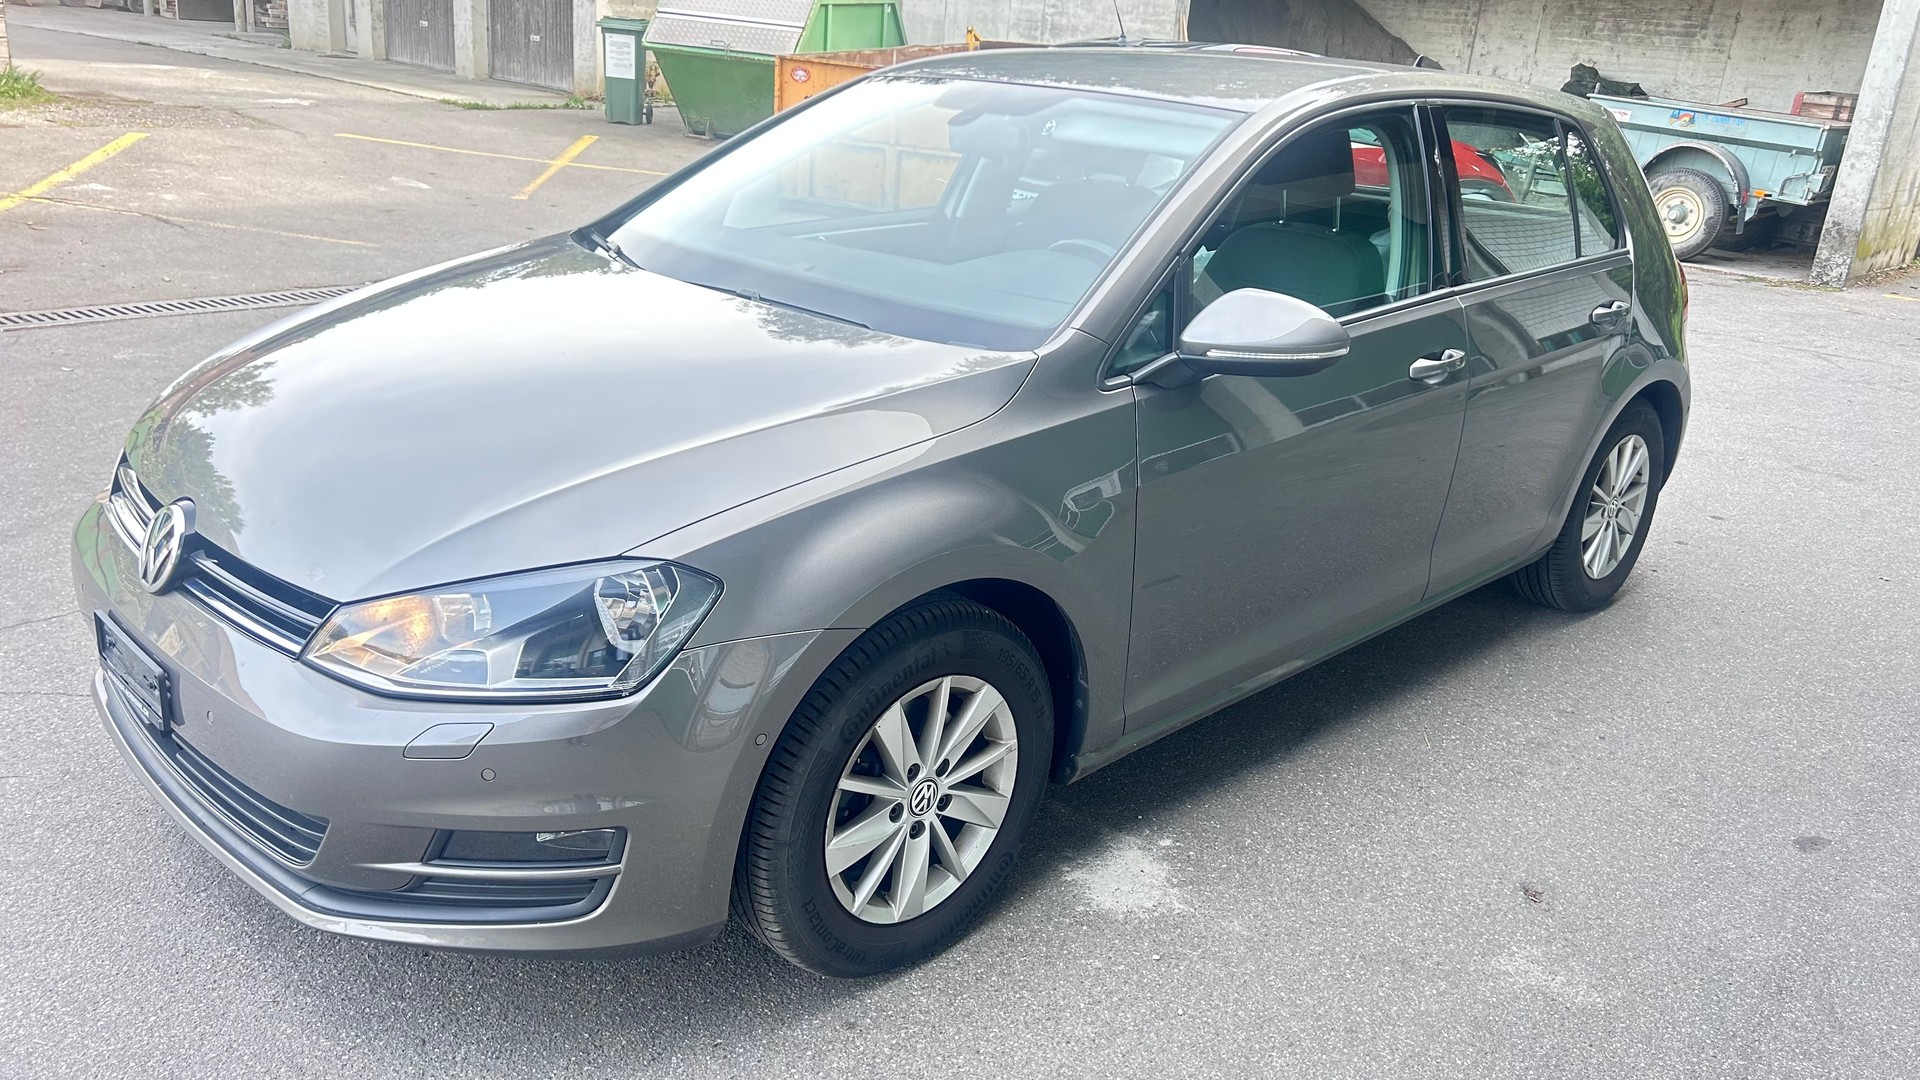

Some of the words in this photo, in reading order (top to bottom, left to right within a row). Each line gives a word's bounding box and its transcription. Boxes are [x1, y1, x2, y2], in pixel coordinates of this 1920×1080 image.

[998, 648, 1031, 680] 195/65
[839, 646, 937, 744] Continental
[1024, 678, 1037, 692] R
[1029, 686, 1042, 703] 15
[802, 896, 866, 965] UltraContact
